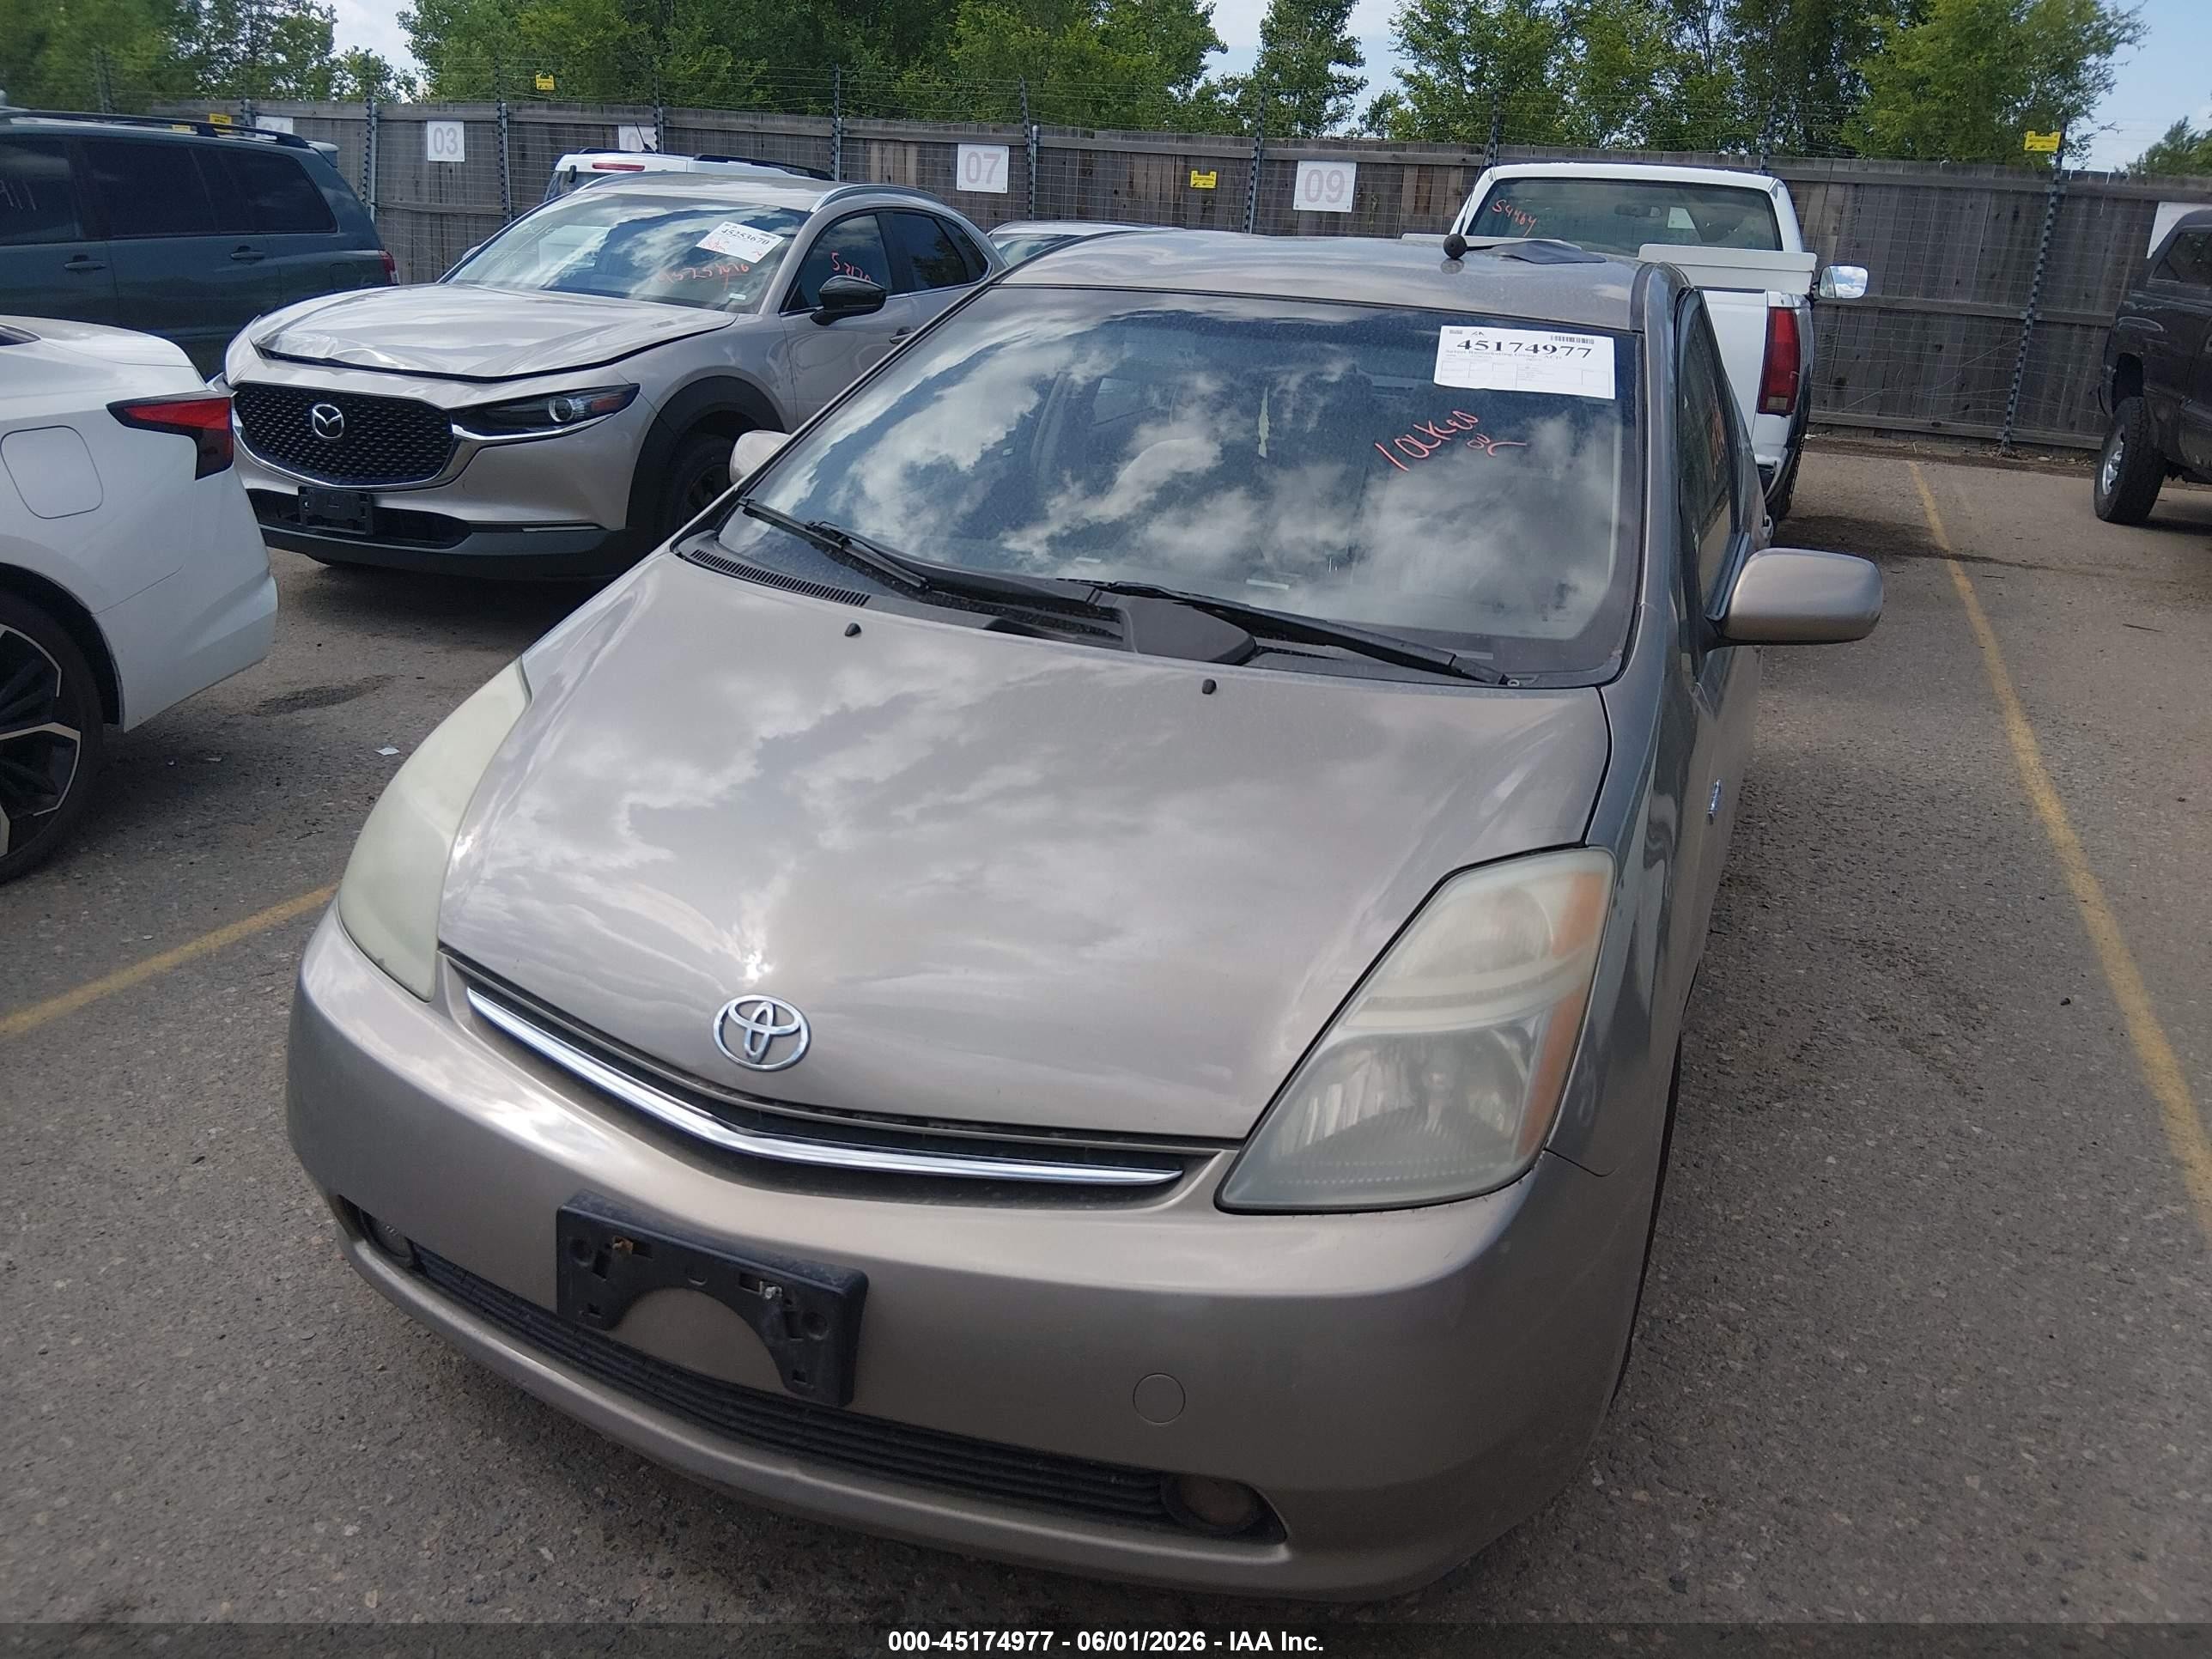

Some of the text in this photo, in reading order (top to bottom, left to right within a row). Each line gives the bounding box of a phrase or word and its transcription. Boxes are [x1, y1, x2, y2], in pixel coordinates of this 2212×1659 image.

[434, 127, 459, 155] 03
[965, 151, 1001, 185] 07
[1305, 168, 1345, 204] 09
[1456, 339, 1592, 359] 45174977
